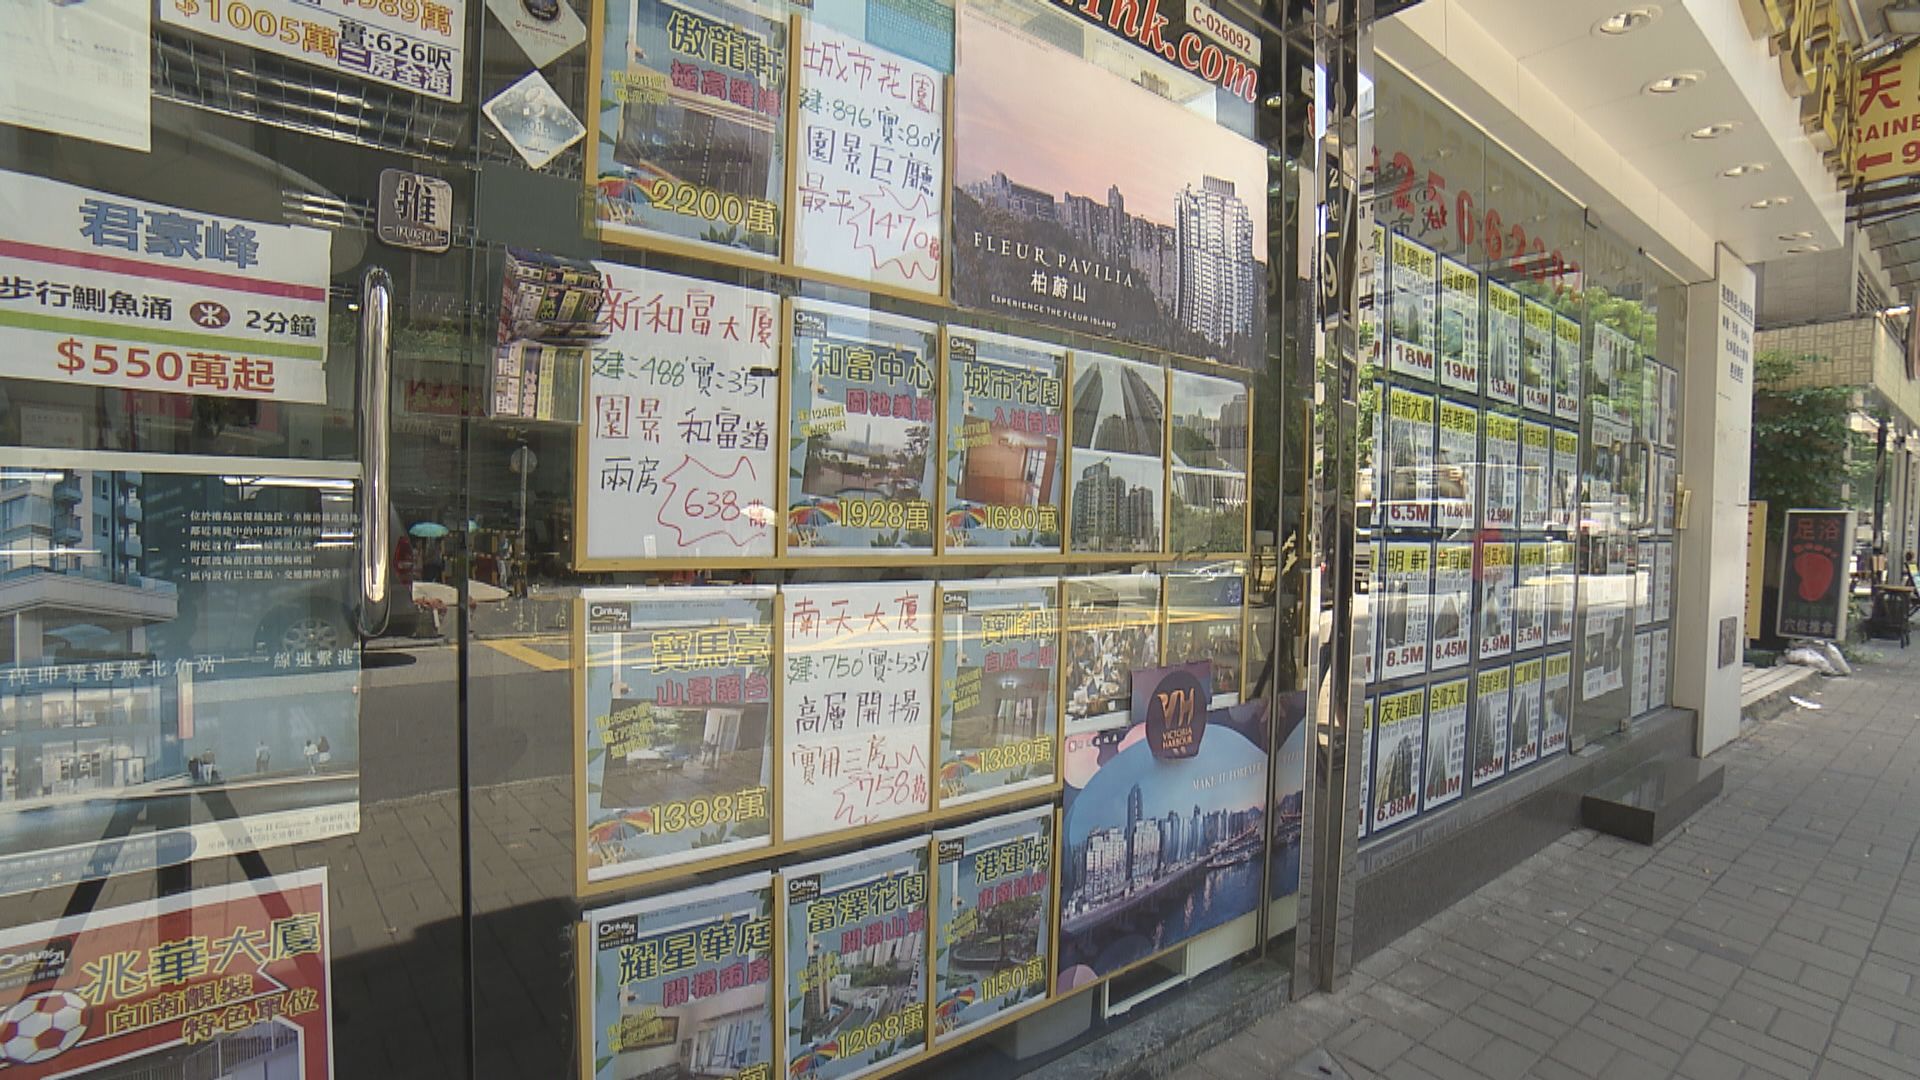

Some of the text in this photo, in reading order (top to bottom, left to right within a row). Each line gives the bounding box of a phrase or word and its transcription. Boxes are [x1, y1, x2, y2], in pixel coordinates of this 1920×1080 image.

[668, 11, 784, 83] 傲龍軒
[1192, 7, 1252, 55] C-026092
[804, 41, 936, 114] 城市花園
[393, 178, 437, 225] 推
[652, 179, 778, 236] 2200萬
[799, 172, 855, 225] 最平
[79, 198, 260, 269] 君豪峰
[973, 231, 1133, 288] FLEUR PAVILIA
[1031, 269, 1087, 304] 柏蔚山
[245, 309, 317, 338] 2分鐘
[598, 273, 774, 349] 新和富大廈
[991, 294, 1117, 329] EXPERIENCE THE FLEUR ISLAND
[56, 337, 276, 394] $550萬起
[811, 342, 936, 391] 和富中心
[1396, 344, 1432, 370] 18M
[1444, 361, 1475, 383] 19M
[962, 362, 1062, 408] 城市花園
[596, 394, 769, 451] 園景 和富道
[838, 500, 931, 532] 1928萬
[984, 503, 1058, 533] 1680萬
[1390, 504, 1430, 522] 6.5M
[1793, 518, 1841, 541] 足浴
[1388, 549, 1428, 573] 明軒
[791, 590, 920, 640] 南天大廈
[1518, 626, 1542, 644] 5.5M
[1386, 645, 1424, 668] 8.5M
[1435, 640, 1467, 658] 8.45M
[1482, 634, 1510, 653] 5.9M
[796, 689, 920, 735] 高層開揚
[1381, 691, 1422, 724] 友福園
[978, 735, 1053, 775] 1388萬
[1162, 726, 1193, 742] VICTORIA
[1162, 738, 1193, 750] HARBOUR
[1193, 776, 1217, 791] MAKE
[649, 785, 767, 836] 1398萬
[1376, 793, 1417, 821] 6.88M
[975, 835, 1049, 887] 港運城
[807, 875, 927, 935] 富澤花園
[80, 913, 321, 1005] 兆華大廈
[618, 917, 772, 987] 耀星華庭
[981, 954, 1046, 1002] 1150萬
[837, 1003, 925, 1059] 1268萬
